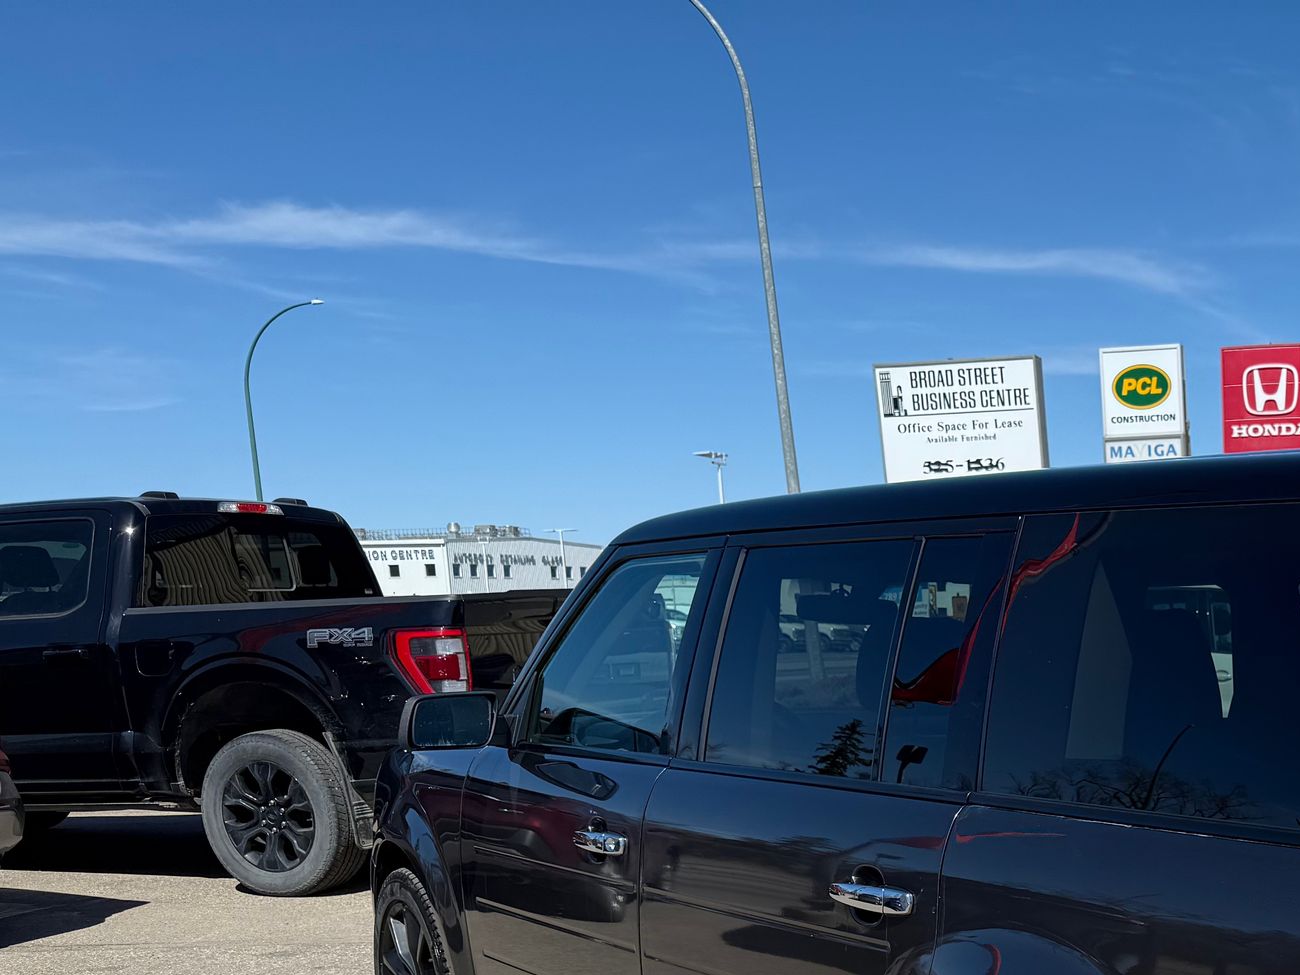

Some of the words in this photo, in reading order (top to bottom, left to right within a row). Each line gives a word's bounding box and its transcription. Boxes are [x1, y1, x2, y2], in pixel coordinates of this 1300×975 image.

[909, 369, 954, 389] BROAD
[957, 366, 1005, 387] STREET
[1120, 377, 1163, 396] PCL
[911, 389, 976, 412] BUSINESS
[979, 387, 1031, 408] CENTRE
[897, 422, 933, 434] Office
[937, 421, 968, 433] Space
[972, 419, 989, 430] For
[994, 418, 1024, 429] Lease
[1110, 413, 1176, 425] CONSTRUCTION
[926, 435, 958, 444] Available
[961, 433, 997, 442] Furnished
[390, 549, 435, 561] CENTRE
[307, 627, 374, 649] FX4
